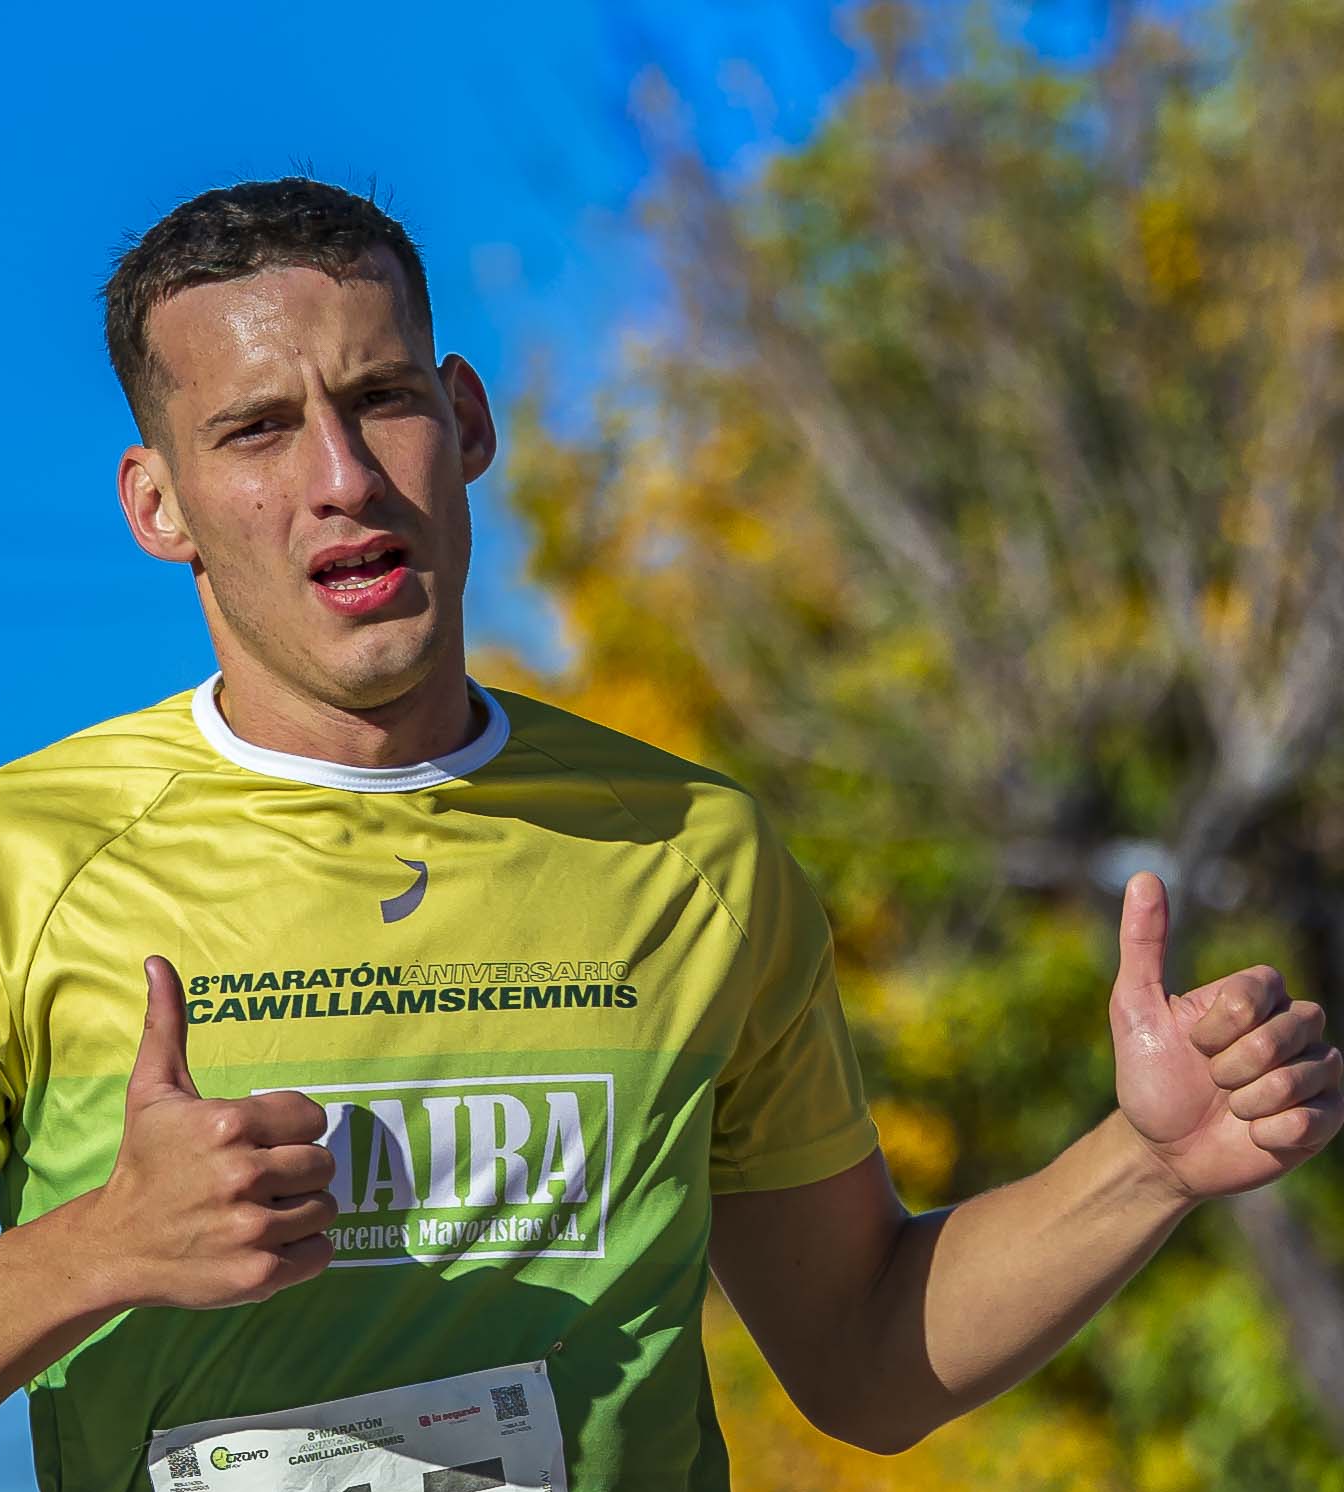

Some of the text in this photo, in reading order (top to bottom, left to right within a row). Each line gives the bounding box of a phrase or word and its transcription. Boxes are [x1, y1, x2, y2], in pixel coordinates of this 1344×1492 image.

[187, 984, 638, 1025] CAWILLIAMSKEMMIS
[322, 1213, 587, 1252] acenes Mayoristas S.A.
[288, 1434, 406, 1466] CAWILLIAMSKEMMIS
